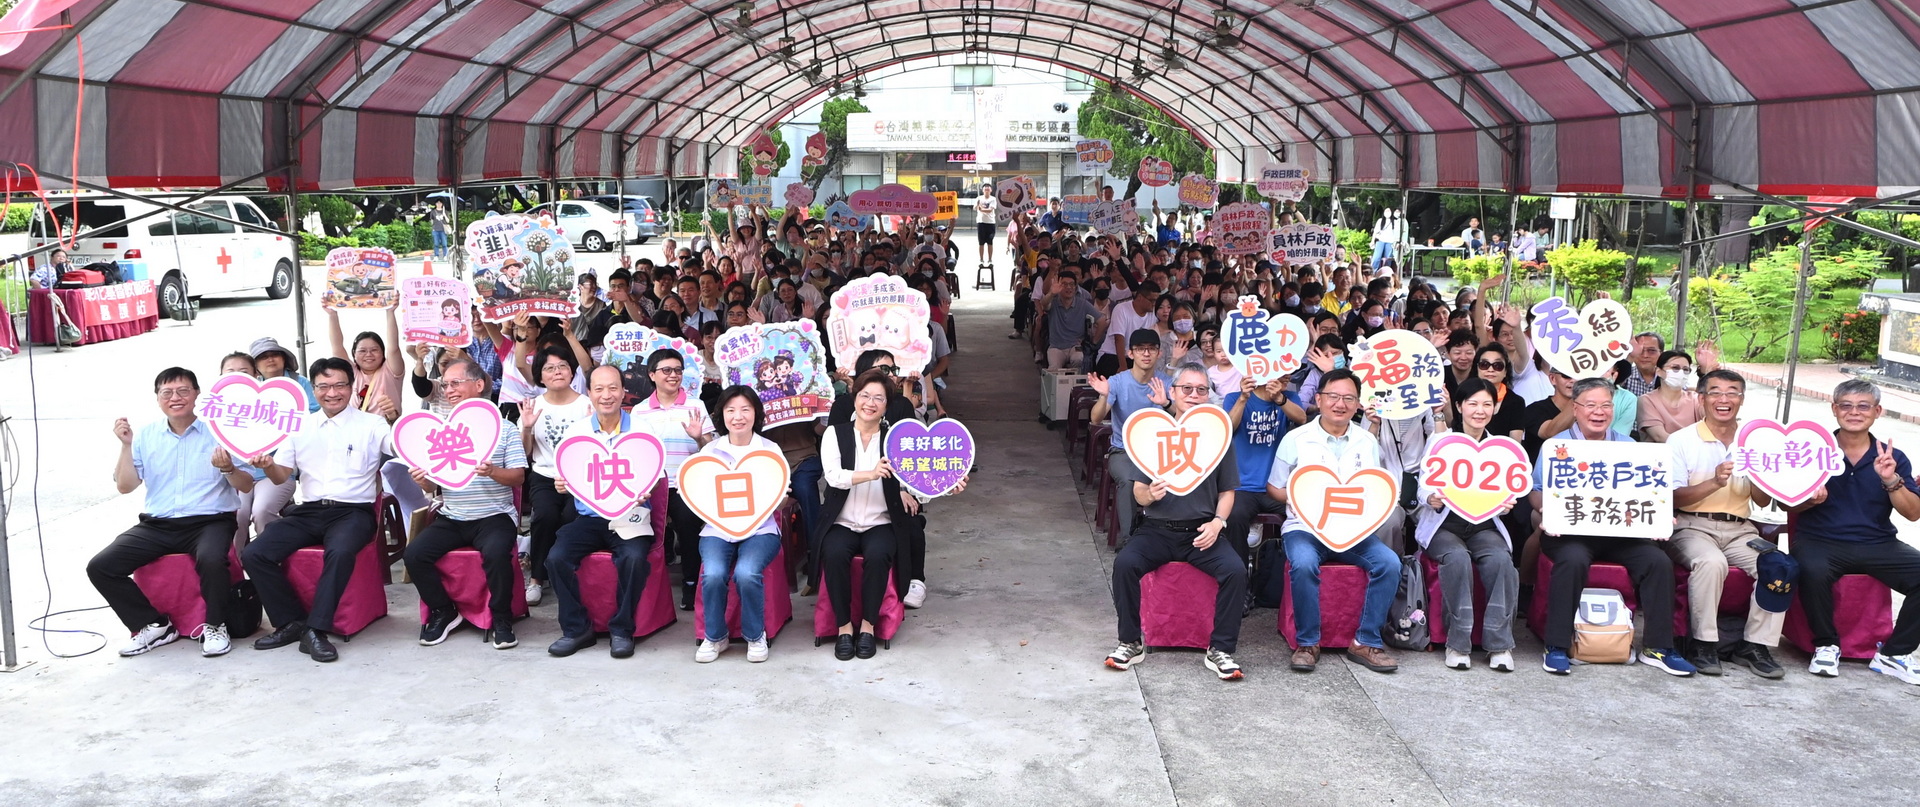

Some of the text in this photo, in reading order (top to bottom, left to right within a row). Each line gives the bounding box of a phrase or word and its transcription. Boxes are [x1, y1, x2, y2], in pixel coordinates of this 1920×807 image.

[886, 134, 913, 142] TAIWAN
[1019, 134, 1049, 142] OPERATION
[1049, 134, 1070, 142] BRANCH
[1263, 169, 1301, 179] 戶政日限定
[1221, 210, 1255, 221] 員林戶政
[479, 222, 514, 237] 入籍溪湖
[1273, 232, 1332, 249] 員林戶政
[1287, 248, 1327, 258] 咱的好厝邊
[84, 280, 153, 301] 彰化基督教醫院
[615, 331, 643, 340] 五分車
[620, 341, 648, 352] 出發!
[728, 333, 751, 350] 愛情
[728, 342, 760, 364] 成熟了!
[1570, 343, 1629, 374] 同心
[1246, 354, 1299, 378] 同心
[1397, 383, 1443, 410] 至上
[199, 393, 304, 433] 希望城市
[426, 423, 478, 474] 樂
[900, 436, 964, 451] 美好彰化
[1157, 431, 1203, 475] 政
[900, 456, 964, 472] 希望城市
[1736, 440, 1840, 473] 美好彰化
[588, 453, 635, 500] 快
[1425, 457, 1528, 493] 2026
[1547, 456, 1669, 490] 鹿港戶政
[715, 472, 755, 518] 日
[1317, 487, 1364, 530] 戶
[1563, 493, 1657, 526] 事務所
